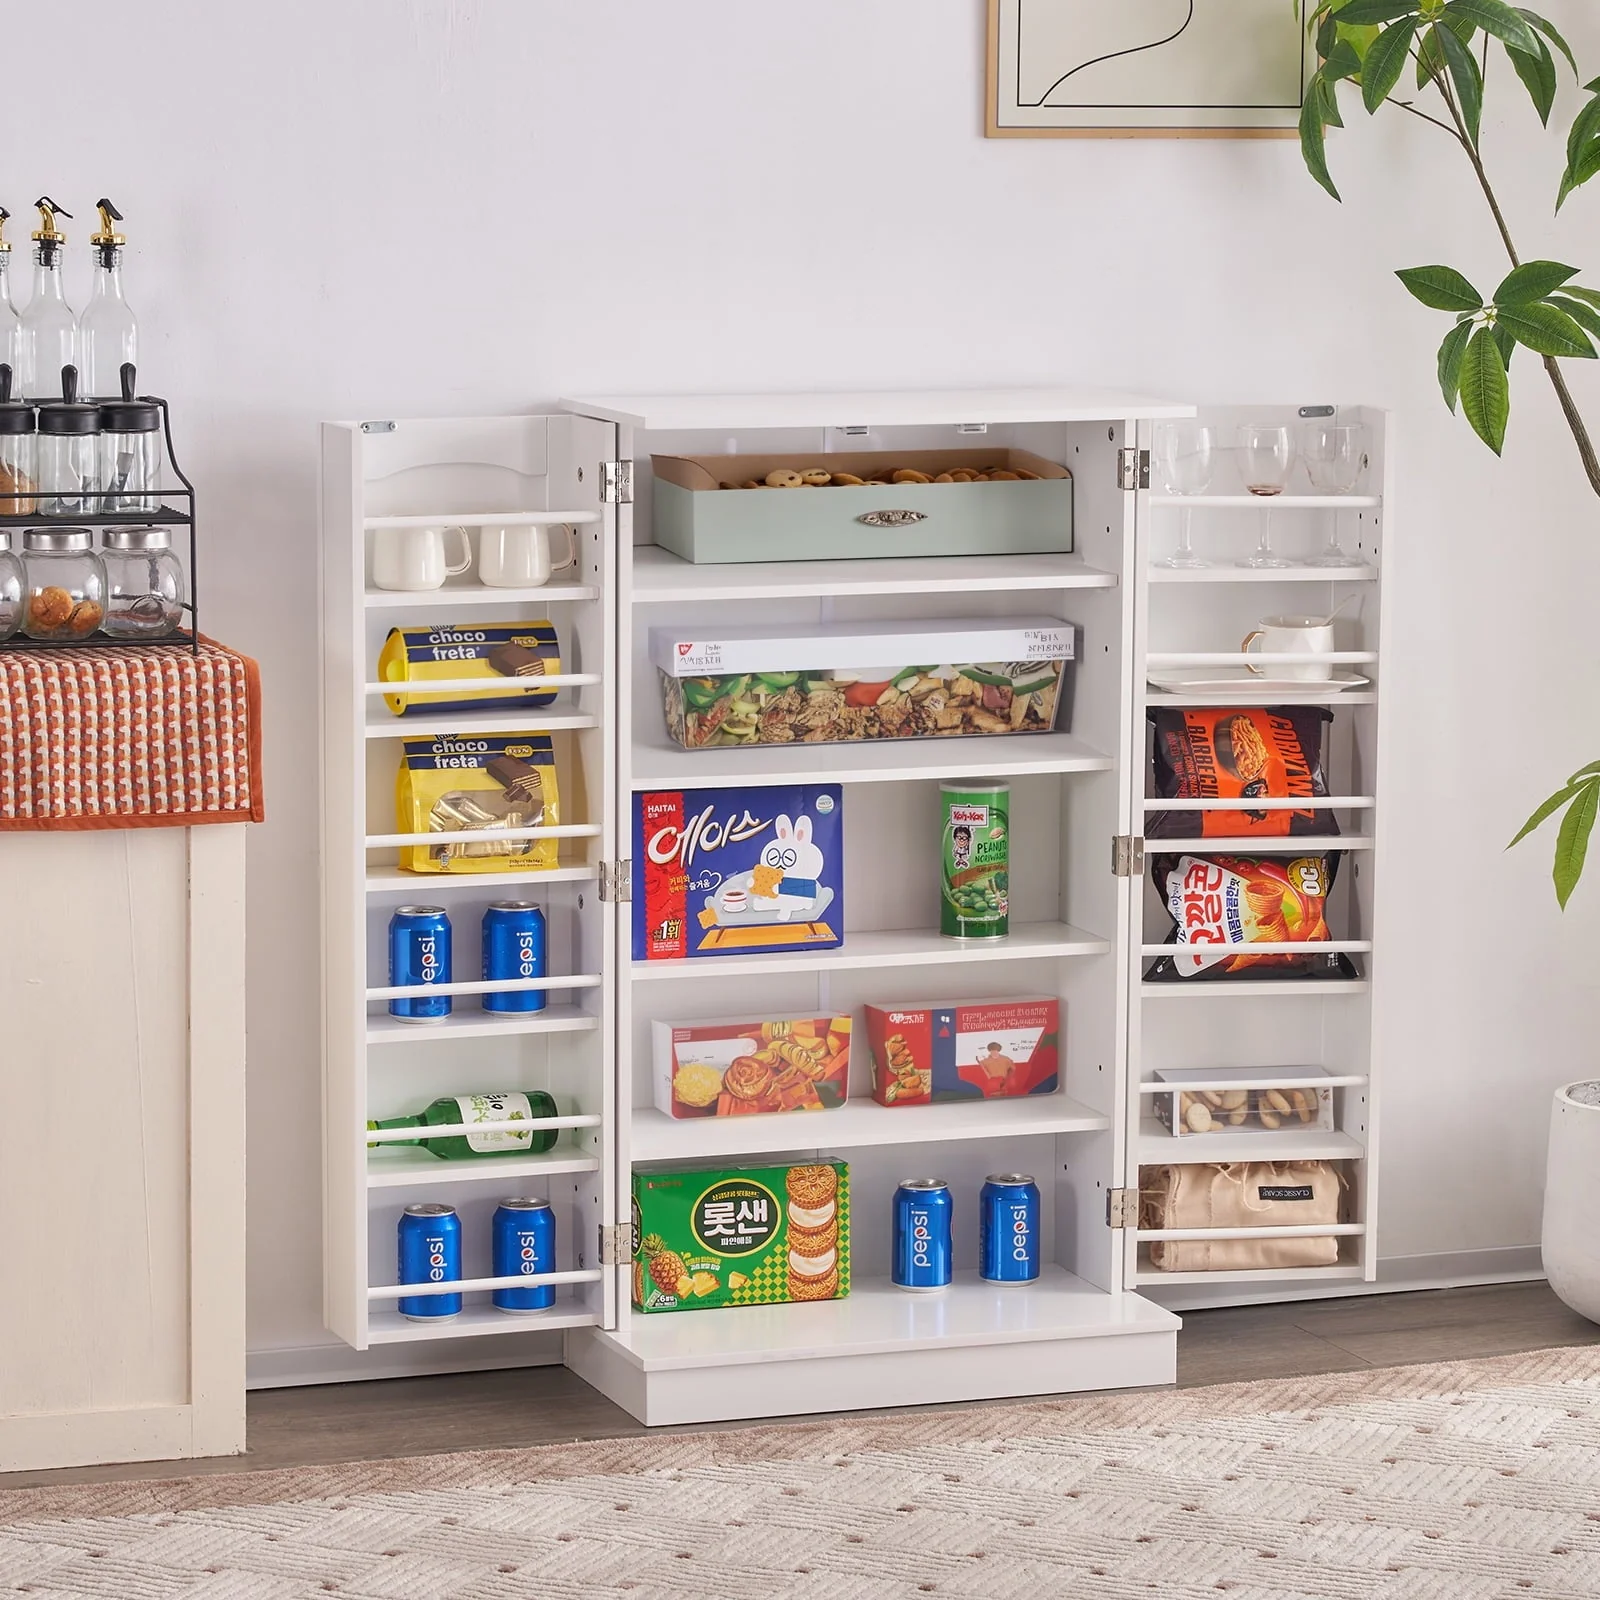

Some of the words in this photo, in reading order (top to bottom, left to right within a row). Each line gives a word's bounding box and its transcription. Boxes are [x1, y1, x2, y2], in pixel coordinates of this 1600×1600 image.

[428, 630, 486, 645] choco
[432, 645, 477, 661] freta
[431, 739, 488, 754] choco
[434, 754, 478, 769] freta
[1186, 725, 1220, 798] BARBECU
[647, 804, 676, 812] HAITAI
[648, 805, 773, 868] 에이스
[418, 936, 440, 985] epsi
[516, 931, 537, 978] epsi
[703, 1199, 768, 1237] 롯샌
[911, 1210, 932, 1267] pepsi
[1010, 1204, 1030, 1262] pepsi
[426, 1237, 448, 1281] epsi
[517, 1231, 539, 1277] epsi
